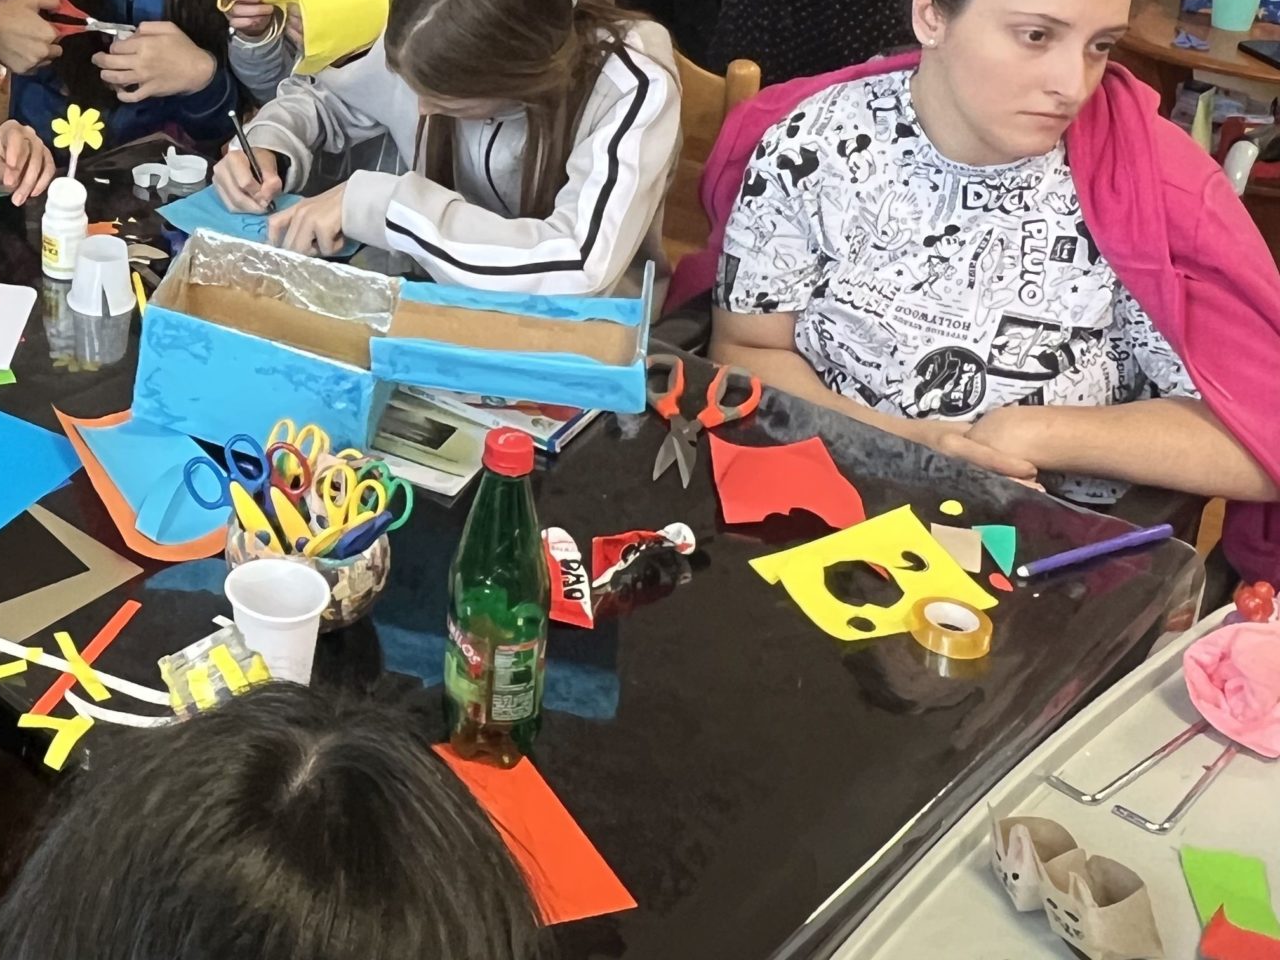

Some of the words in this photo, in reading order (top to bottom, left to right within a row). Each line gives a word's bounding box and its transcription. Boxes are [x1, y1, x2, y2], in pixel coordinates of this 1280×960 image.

[962, 183, 1040, 215] DUCK
[1019, 218, 1049, 307] PLUTO
[894, 305, 972, 332] HOLLYWOOD
